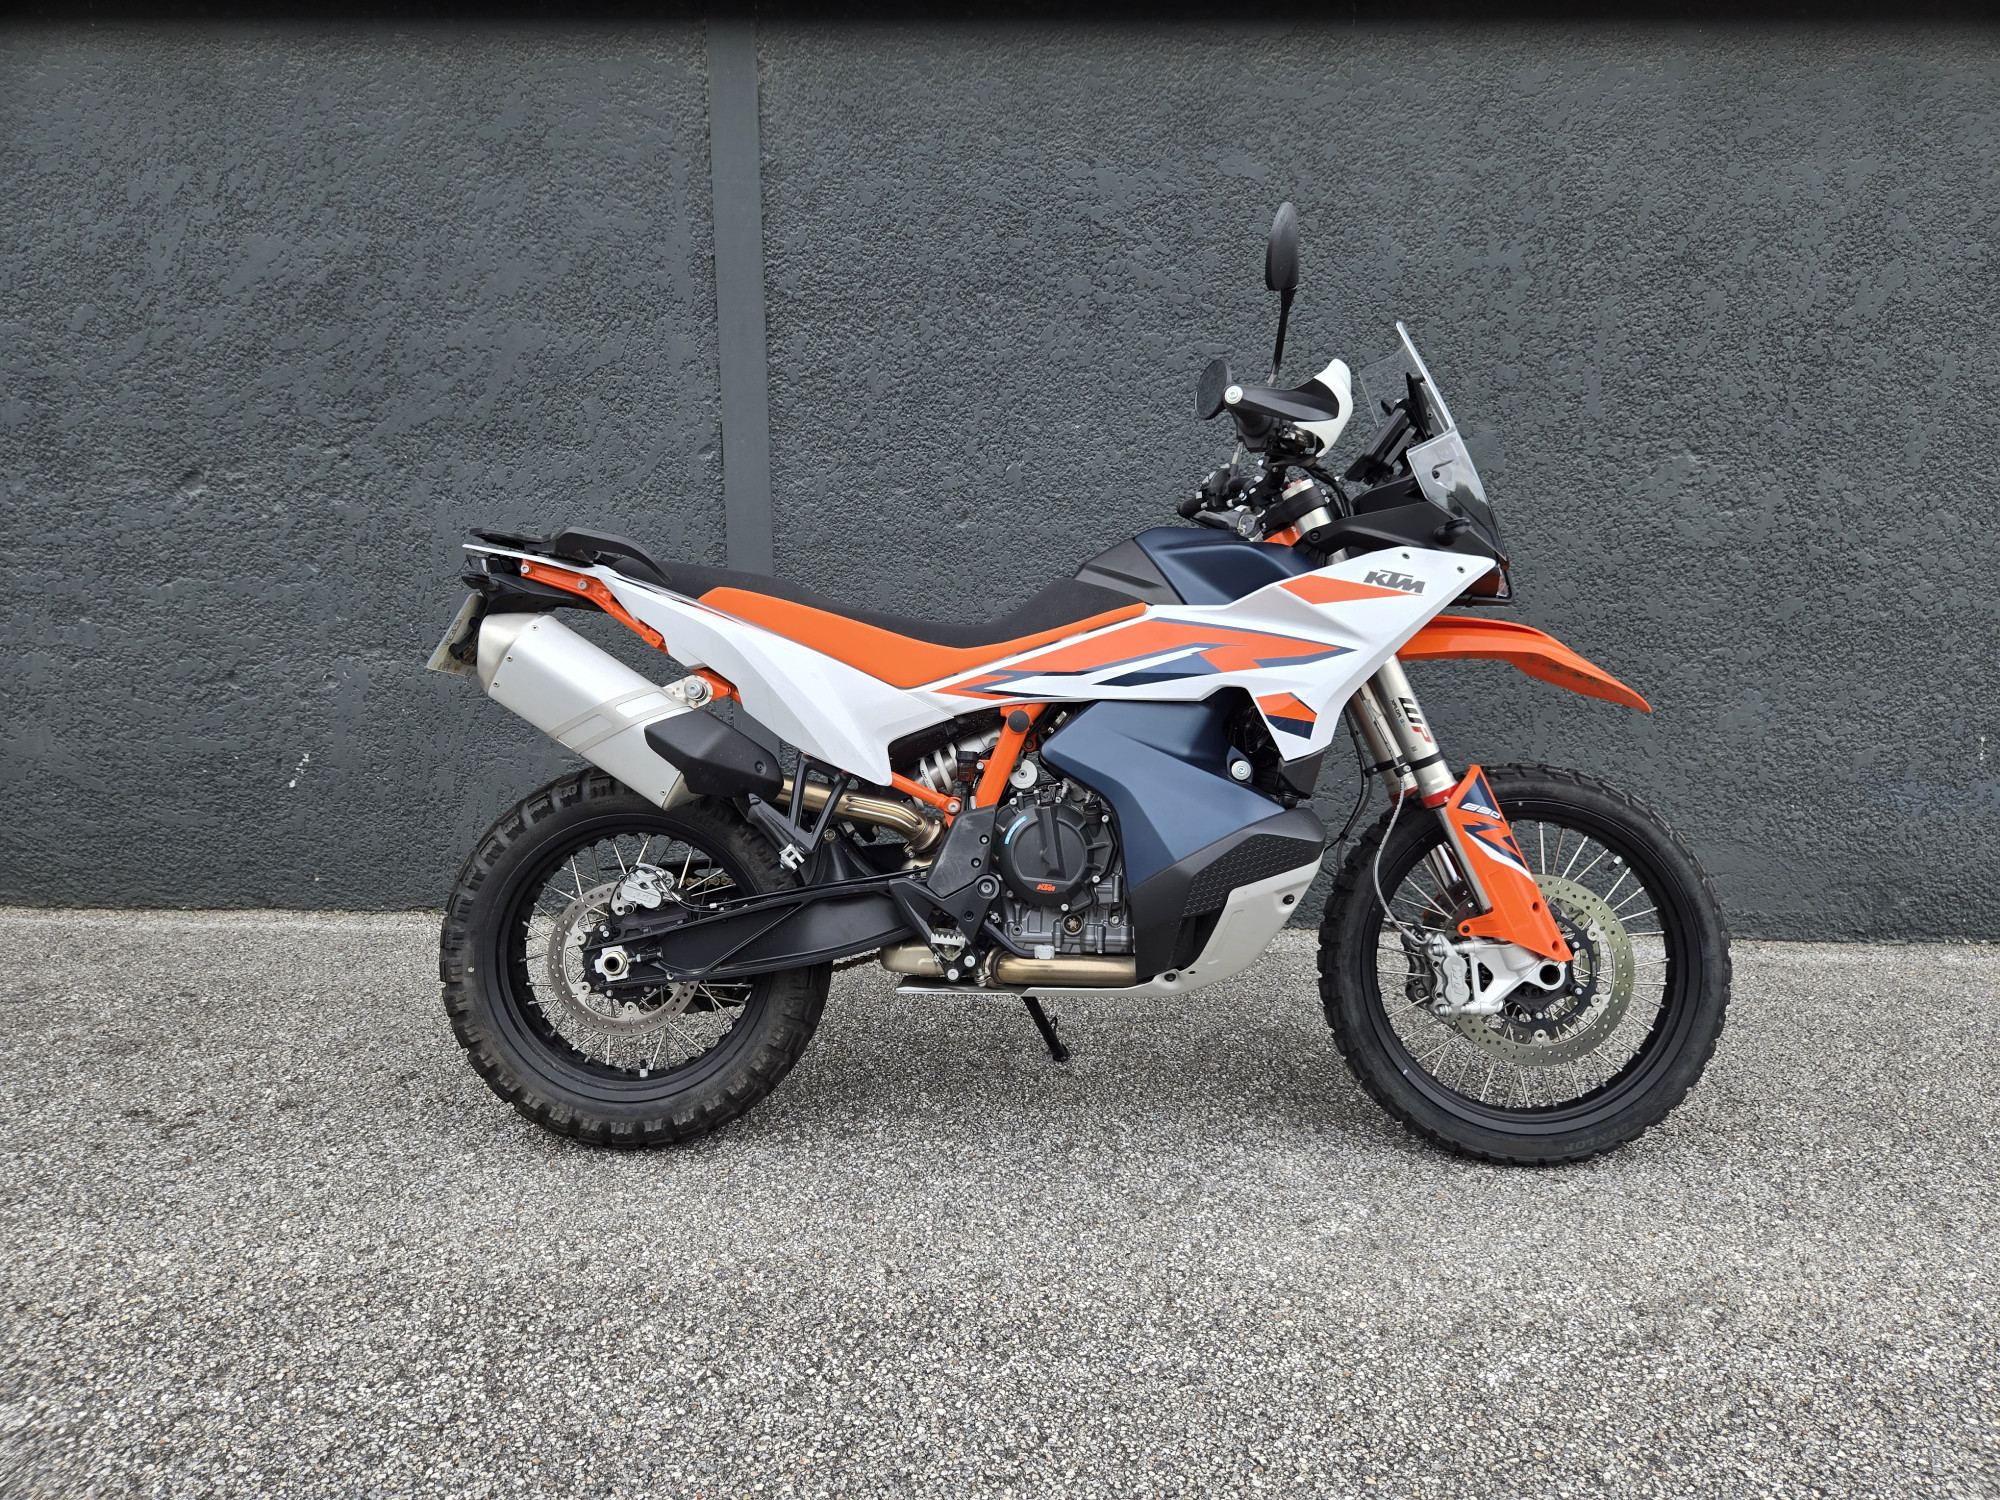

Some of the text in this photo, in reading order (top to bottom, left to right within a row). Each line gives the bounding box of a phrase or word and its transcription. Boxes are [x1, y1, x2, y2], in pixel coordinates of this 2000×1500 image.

[1363, 569, 1426, 594] KTM
[1398, 697, 1432, 743] WP
[1461, 802, 1501, 820] 890
[1036, 883, 1056, 892] KTM
